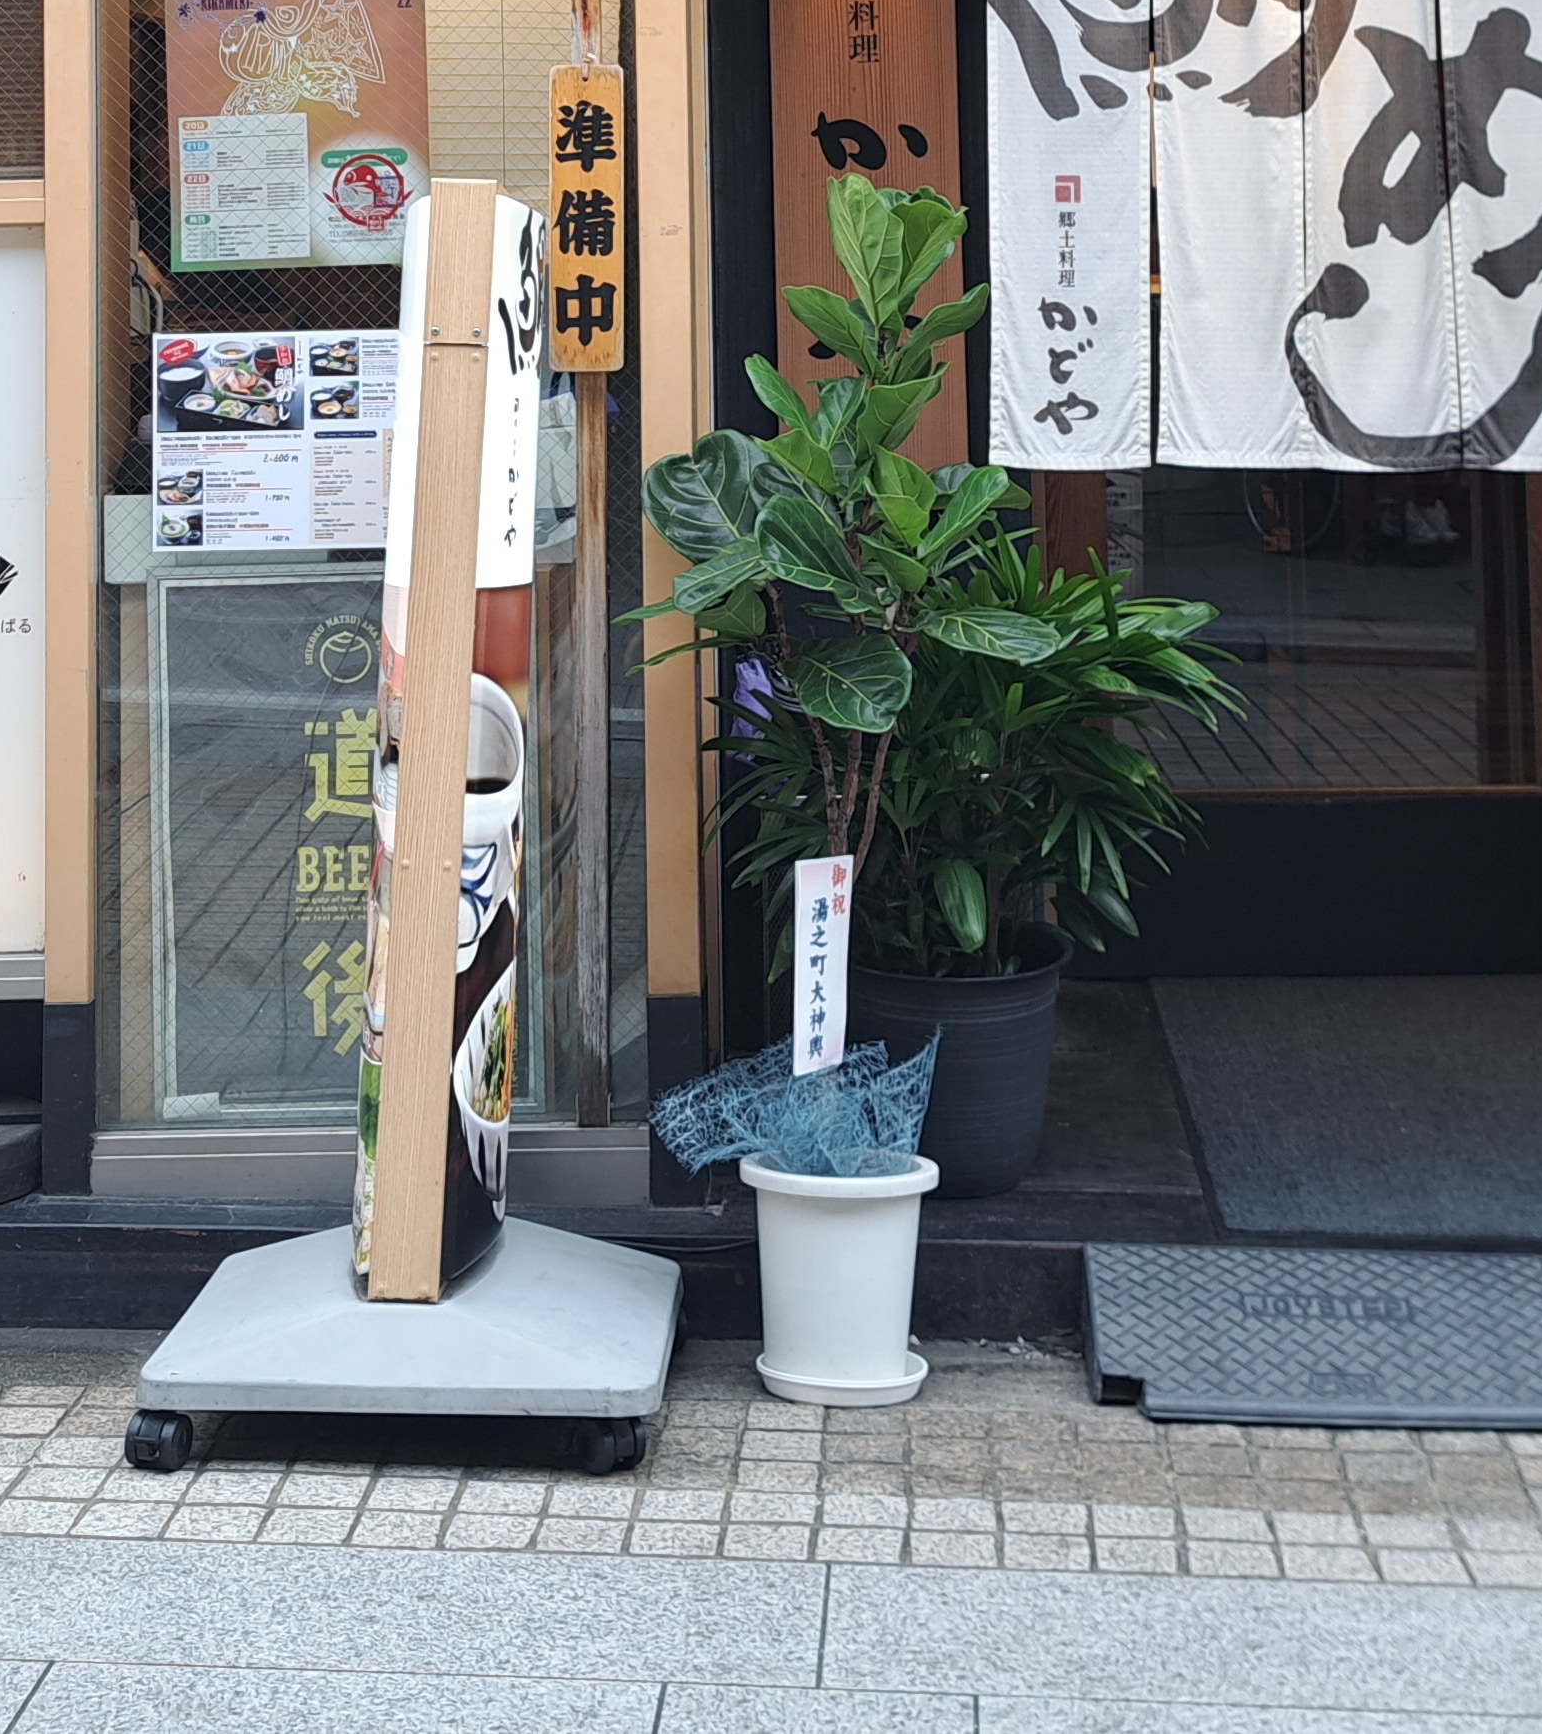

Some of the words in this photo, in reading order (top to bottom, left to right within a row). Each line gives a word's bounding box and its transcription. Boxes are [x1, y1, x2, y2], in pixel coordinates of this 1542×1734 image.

[551, 99, 617, 347] 準備中
[1058, 211, 1075, 288] 郷土料理
[1033, 297, 1099, 435] かどや
[296, 845, 370, 892] BEE
[830, 863, 848, 915] 御祝
